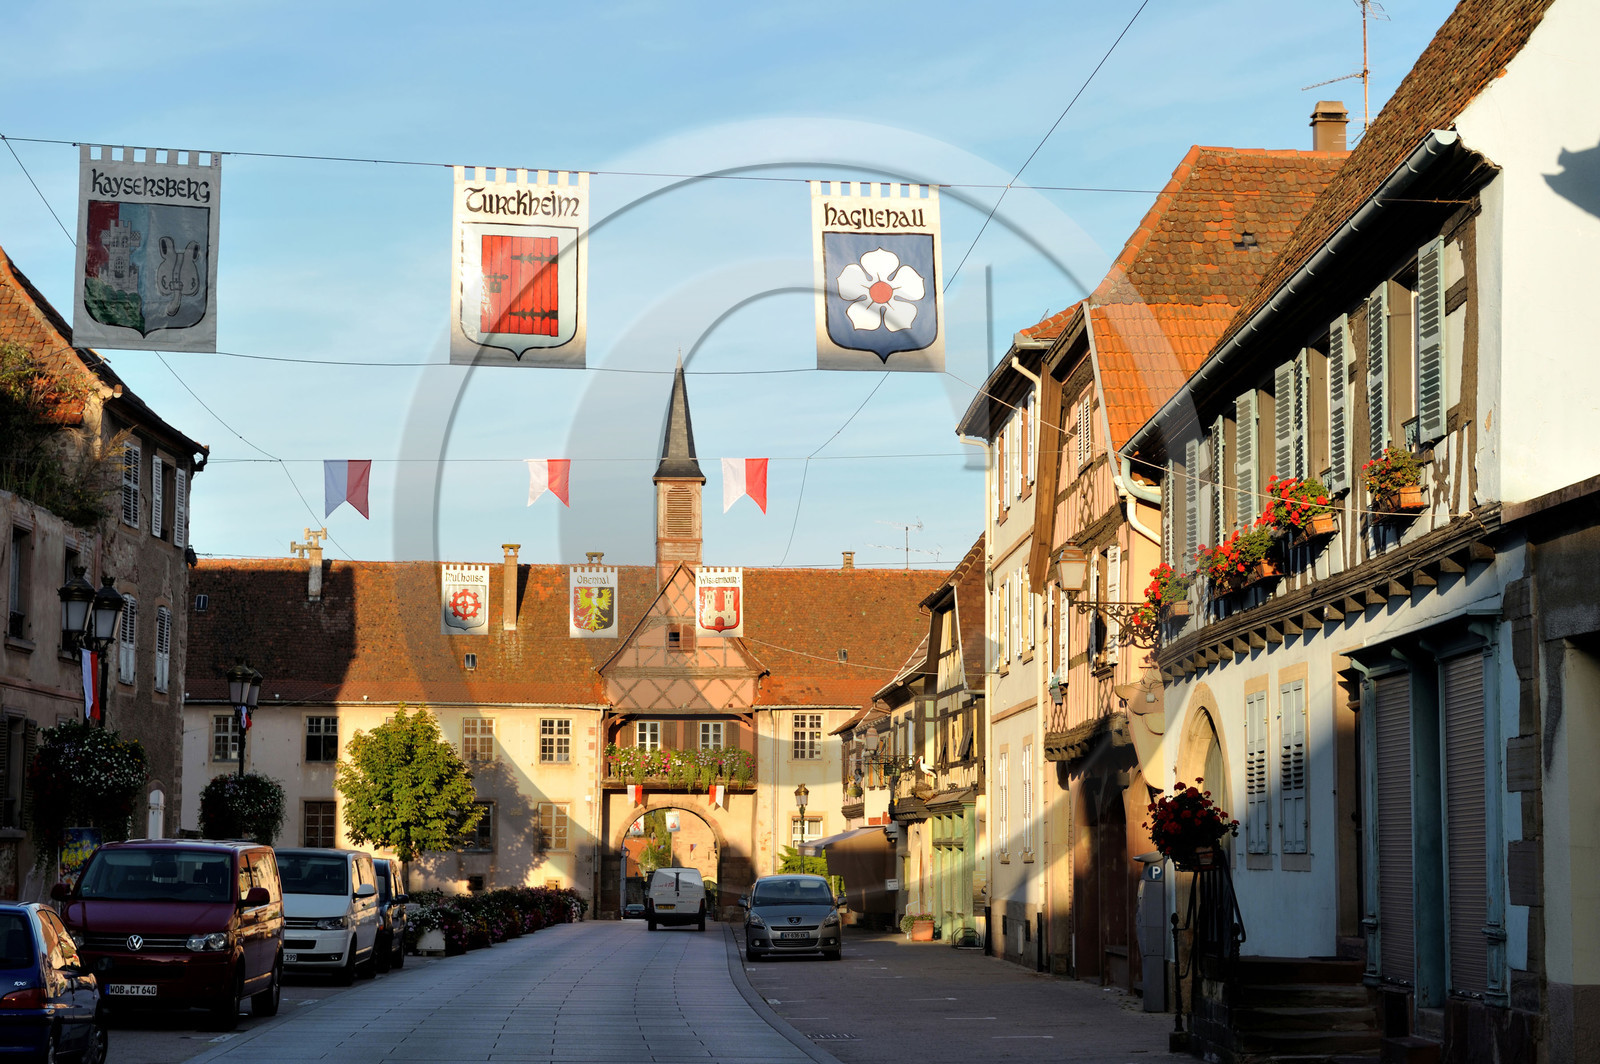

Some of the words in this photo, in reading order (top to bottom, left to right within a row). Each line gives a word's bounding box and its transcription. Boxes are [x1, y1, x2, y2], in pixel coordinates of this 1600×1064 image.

[1152, 865, 1161, 879] P
[110, 985, 125, 993] WOB
[130, 986, 140, 994] CT
